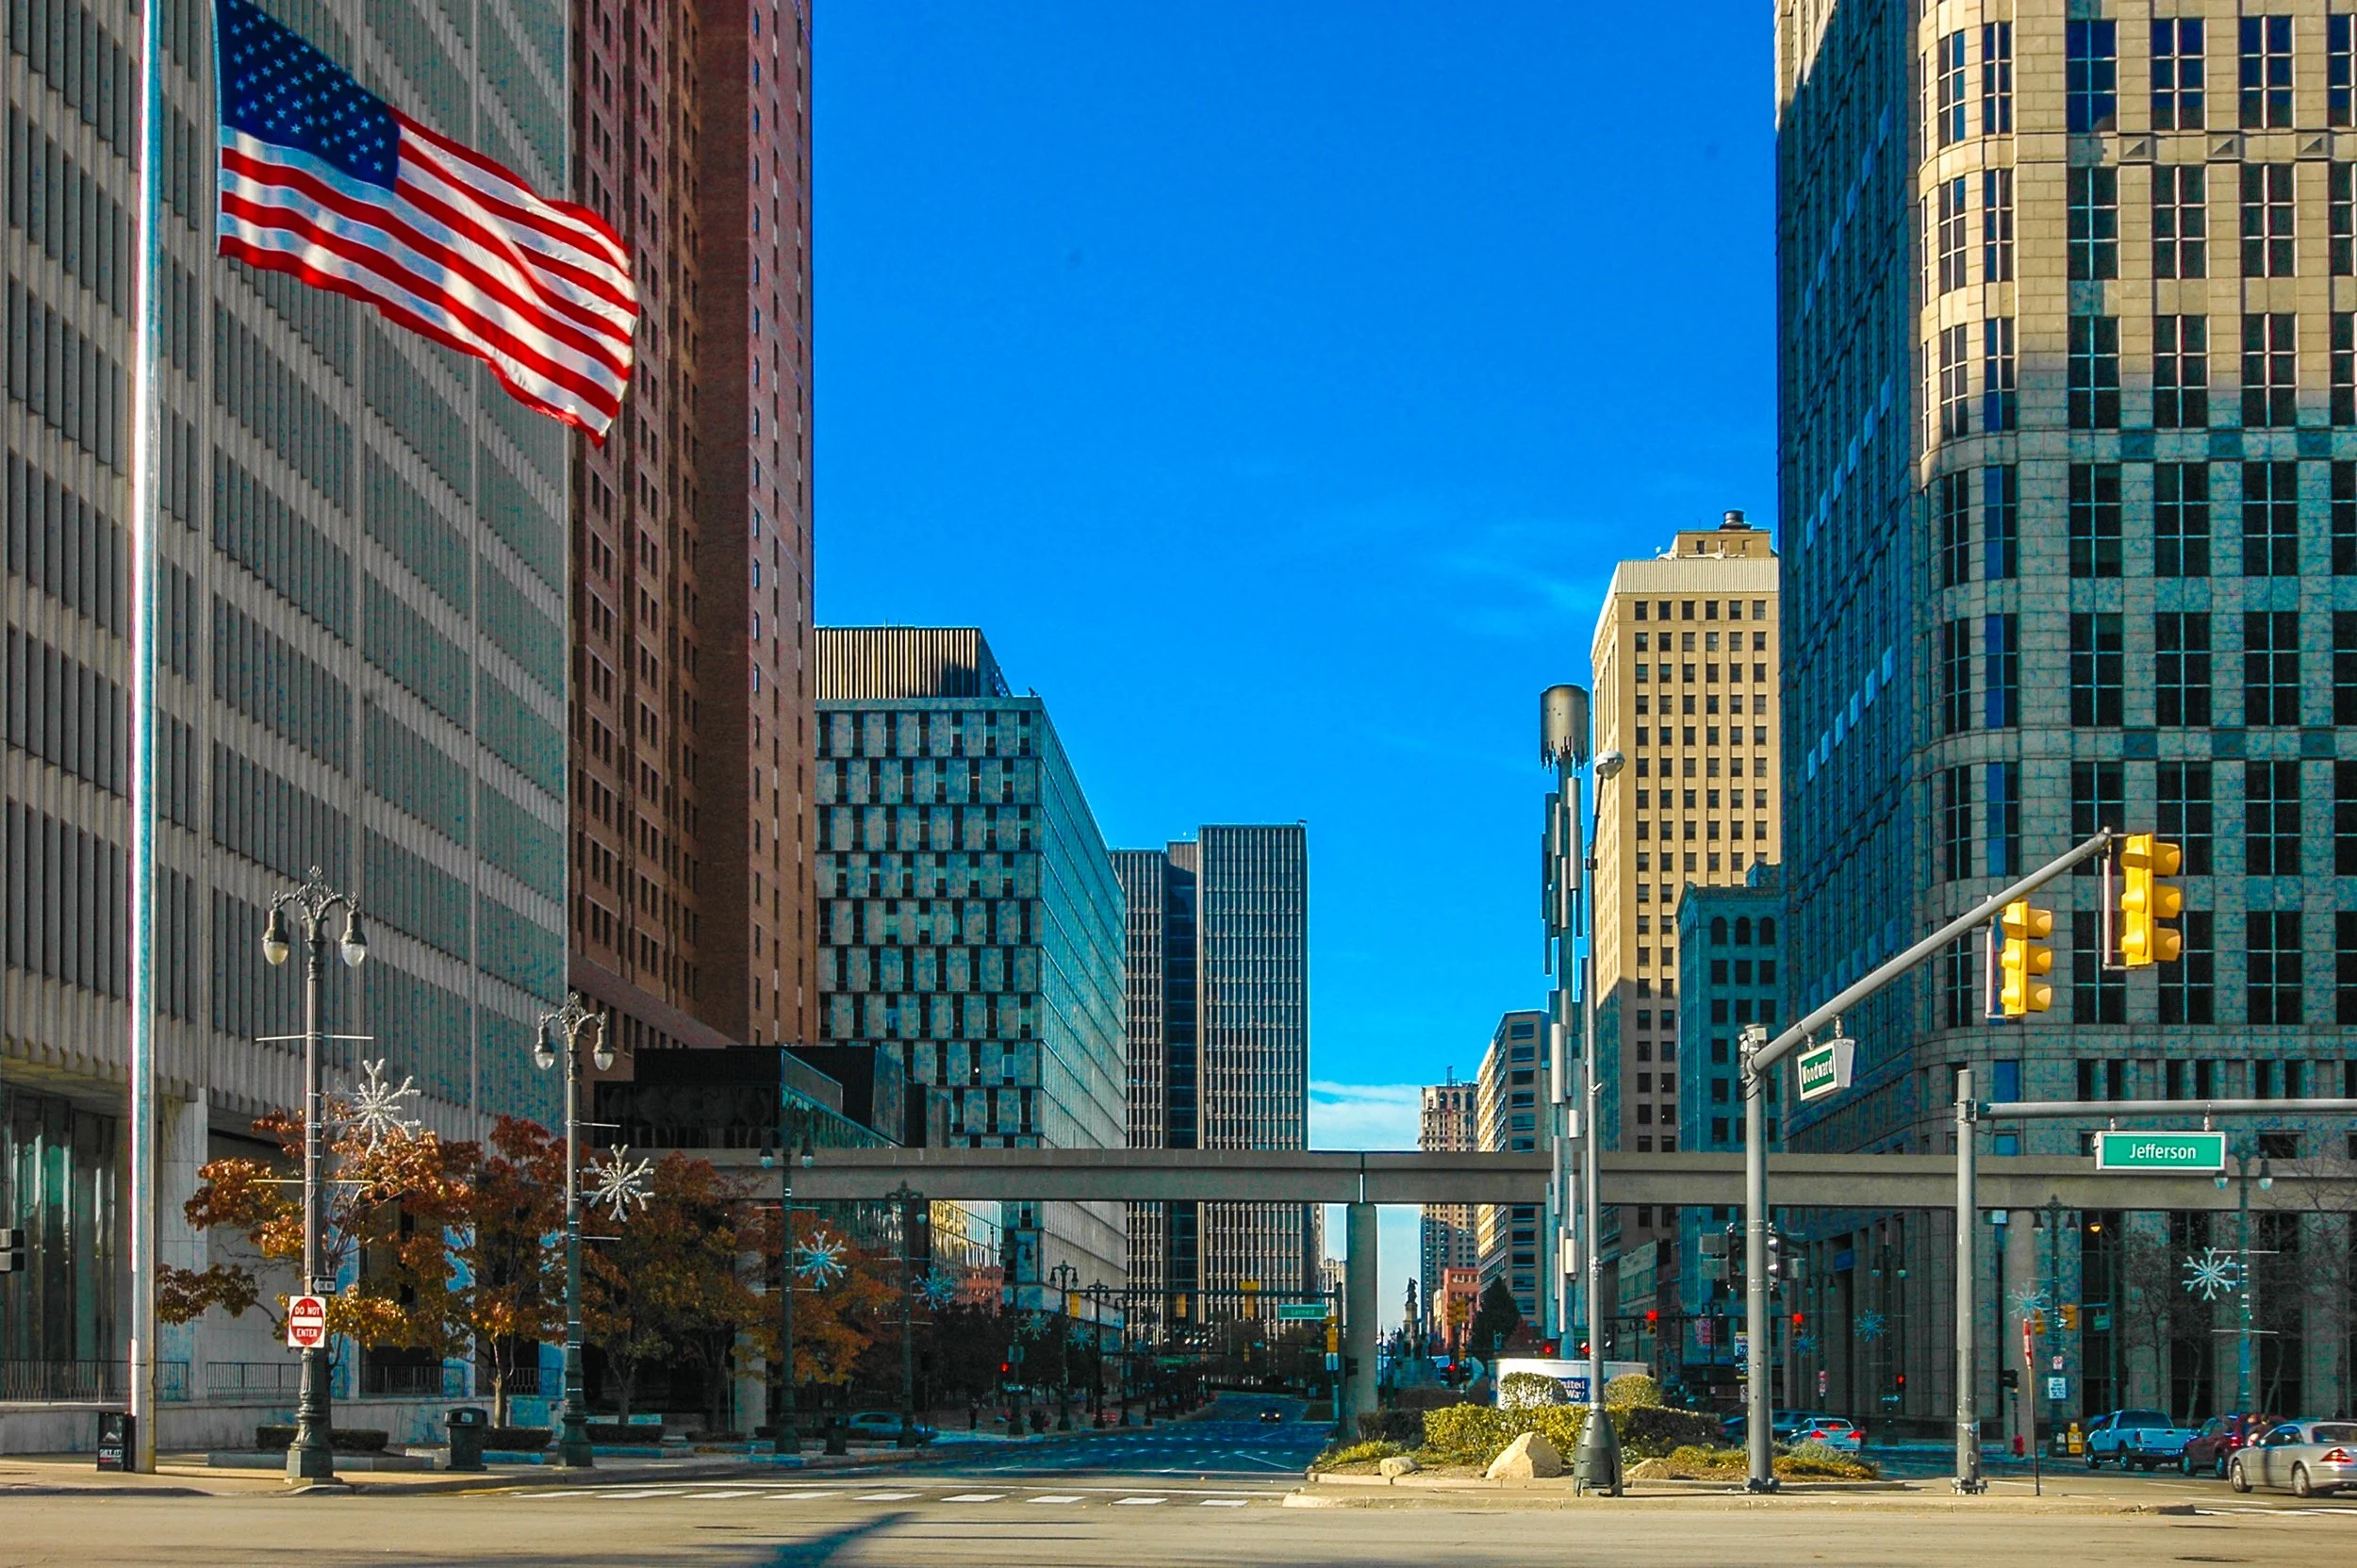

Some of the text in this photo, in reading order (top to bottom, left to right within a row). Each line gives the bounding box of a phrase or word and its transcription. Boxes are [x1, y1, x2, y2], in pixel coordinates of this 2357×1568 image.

[1802, 1055, 1833, 1084] Woodward
[2129, 1143, 2197, 1160] Jefferson
[294, 1306, 320, 1315] DO NOT
[296, 1328, 318, 1338] ENTER
[1565, 1389, 1585, 1402] Way
